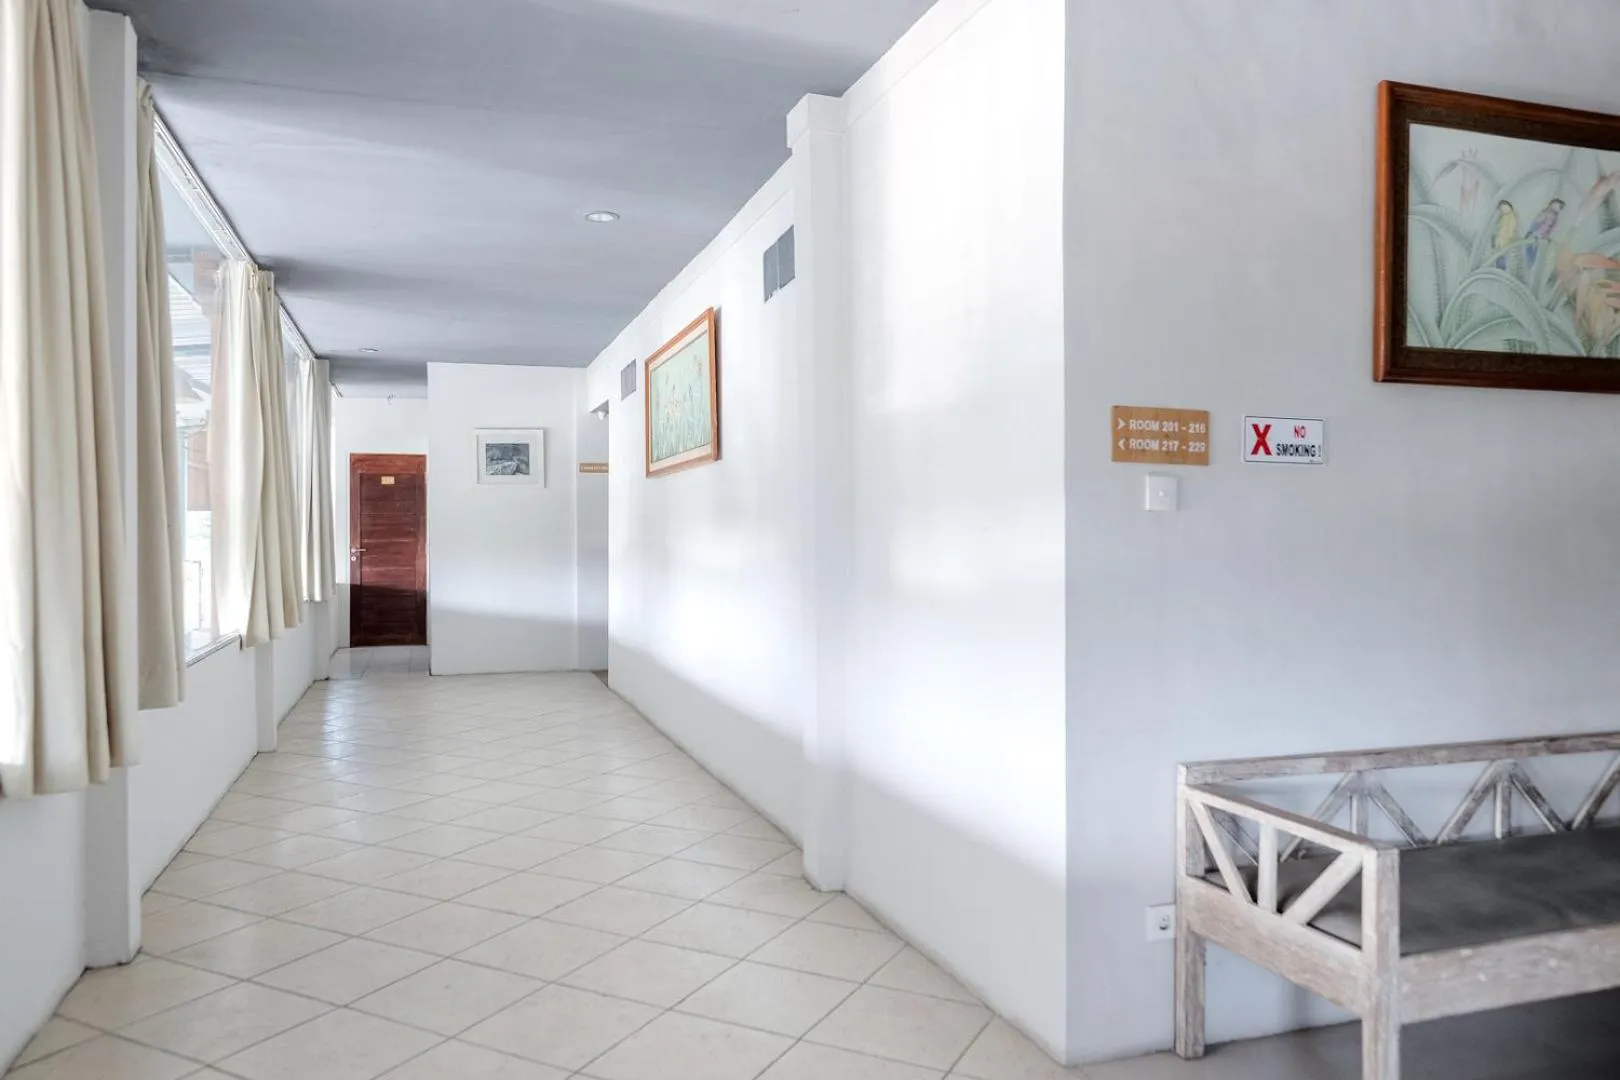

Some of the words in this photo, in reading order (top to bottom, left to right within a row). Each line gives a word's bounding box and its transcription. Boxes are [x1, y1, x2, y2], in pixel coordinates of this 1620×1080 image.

[1129, 419, 1160, 432] ROOM
[1162, 421, 1179, 433] 201
[1293, 425, 1306, 439] NO
[1129, 439, 1160, 451] ROOM
[1162, 440, 1179, 452] 217
